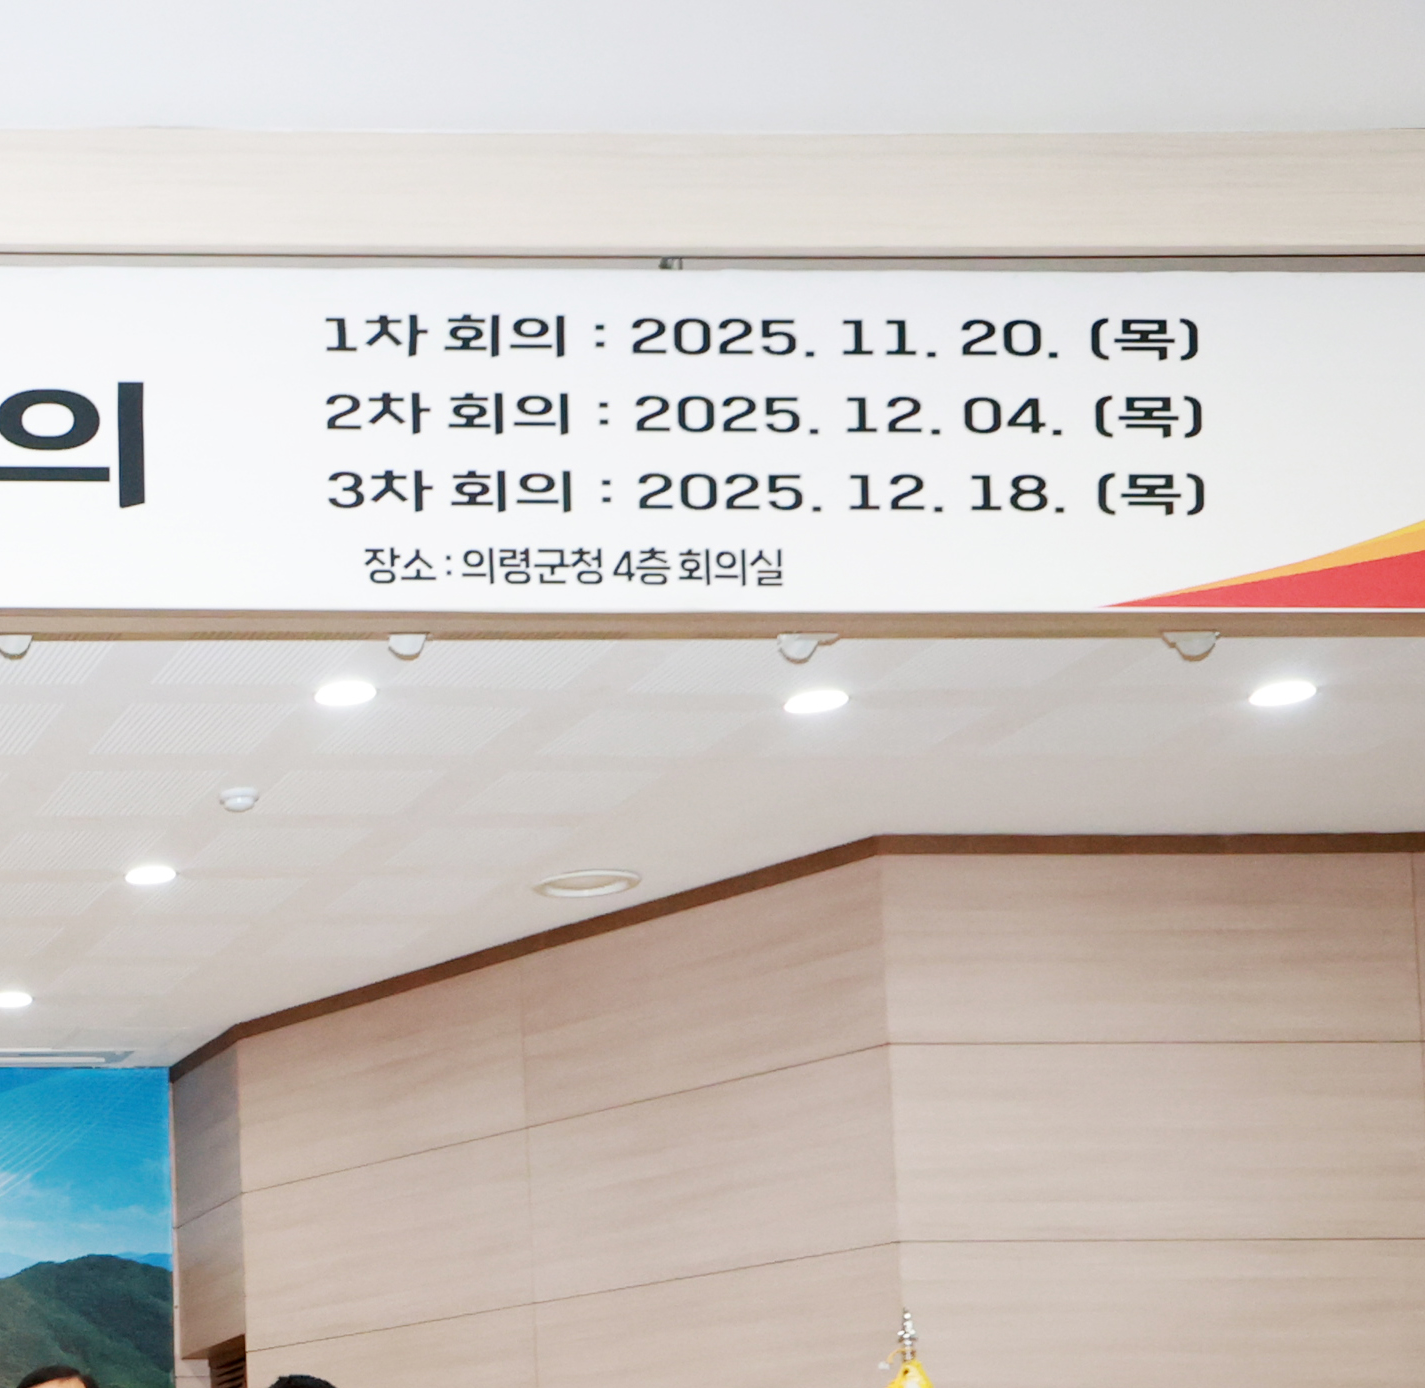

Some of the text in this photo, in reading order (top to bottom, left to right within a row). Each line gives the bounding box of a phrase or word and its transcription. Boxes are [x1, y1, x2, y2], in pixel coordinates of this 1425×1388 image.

[326, 315, 427, 356] 1차
[445, 315, 564, 357] 회의
[632, 318, 814, 357] 2025.
[843, 319, 936, 357] 11.
[962, 319, 1057, 358] 20.
[1091, 318, 1199, 361] (목)
[327, 393, 430, 434] 2차
[449, 393, 568, 436] 회의
[636, 396, 818, 434] 2025.
[847, 396, 940, 434] 12.
[964, 397, 1061, 435] 04.
[1095, 396, 1203, 439] (목)
[329, 470, 432, 512] 3차
[452, 470, 571, 513] 회의
[639, 474, 821, 512] 2025.
[850, 474, 942, 512] 12.
[972, 475, 1064, 513] 18.
[1098, 473, 1205, 516] (목)
[613, 547, 671, 585] 4층
[680, 548, 783, 586] 회의실
